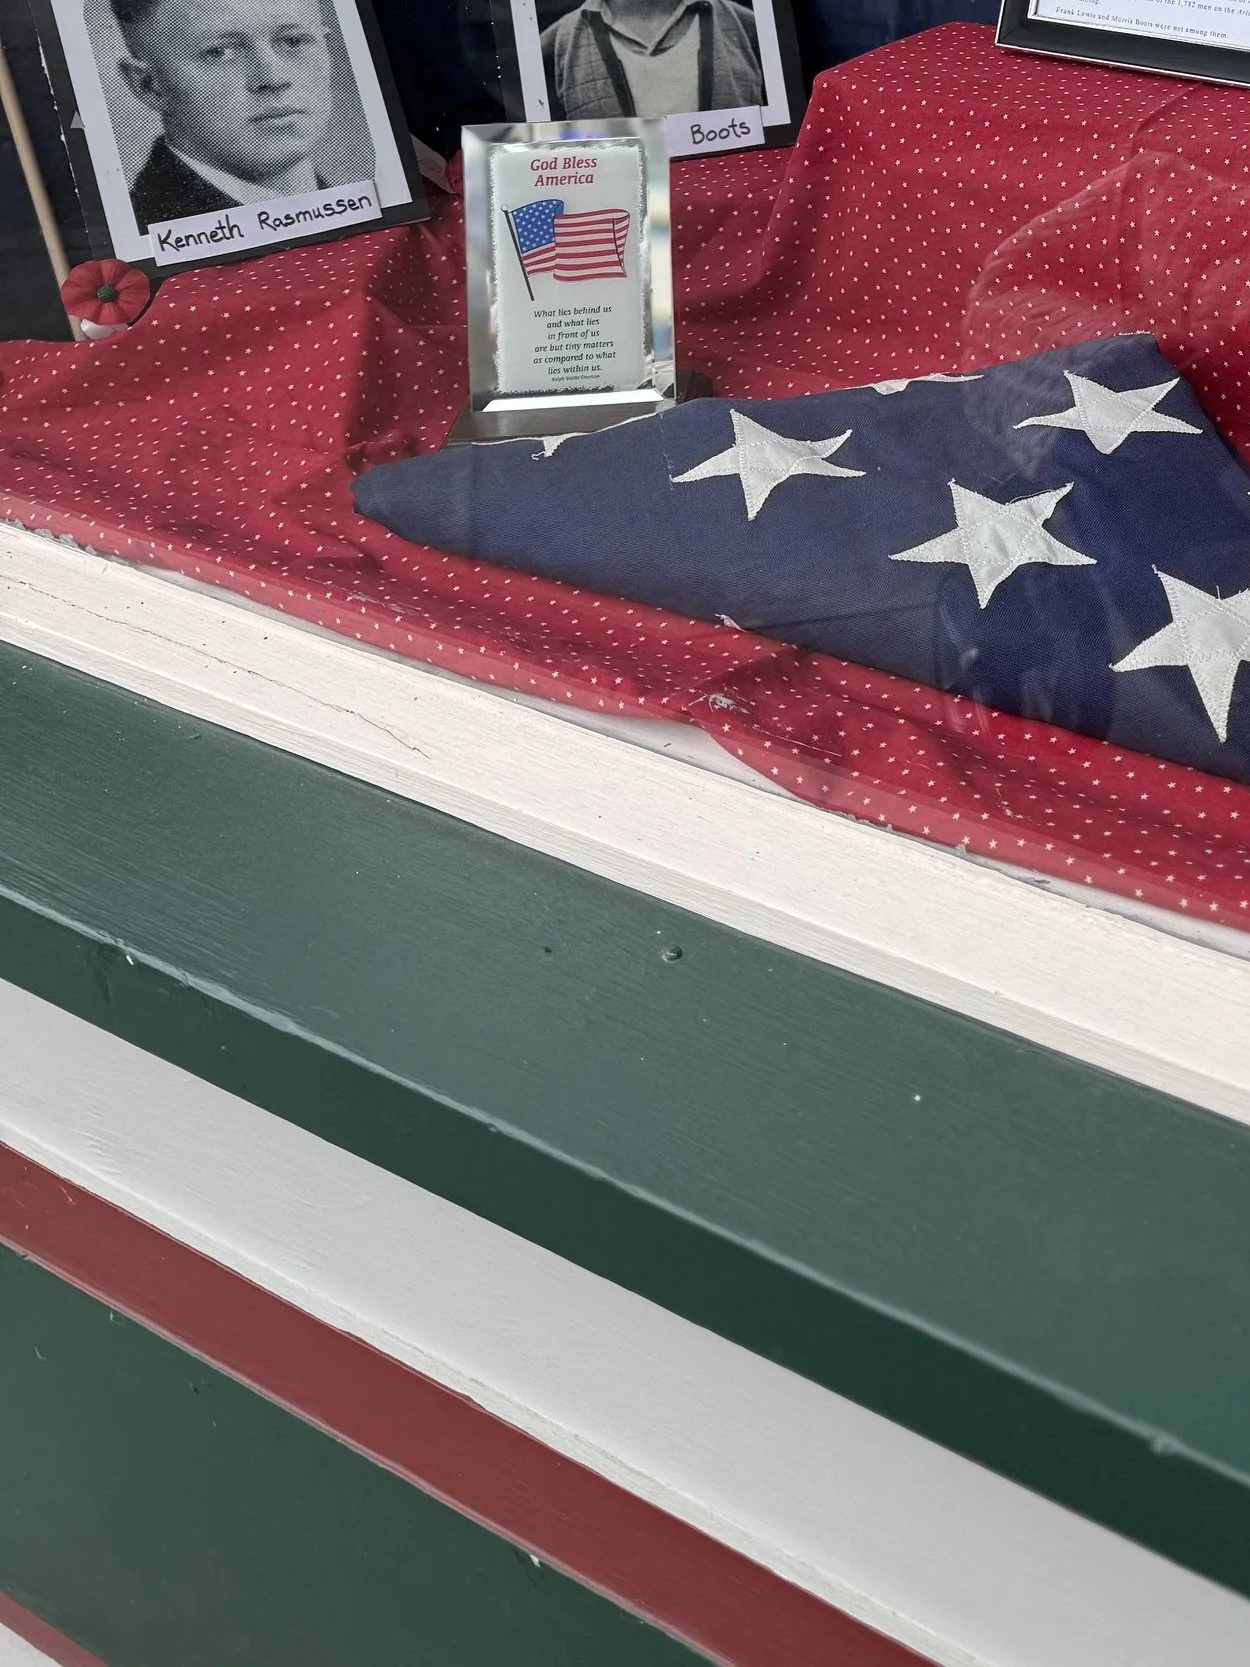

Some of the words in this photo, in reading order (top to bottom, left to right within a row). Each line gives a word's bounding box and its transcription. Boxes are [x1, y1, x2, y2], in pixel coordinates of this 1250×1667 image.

[1055, 6, 1074, 14] Frank
[1077, 9, 1095, 18] Lewis
[1098, 12, 1109, 20] and
[1111, 14, 1133, 24] Morris
[1135, 18, 1153, 27] Boots
[1185, 27, 1207, 37] among
[690, 118, 750, 145] Boots
[531, 157, 557, 171] God
[563, 156, 597, 169] Bless
[534, 172, 594, 186] America
[157, 214, 244, 252] Kenneth
[257, 195, 372, 231] Rasmussen
[559, 308, 571, 316] lies
[574, 306, 600, 315] behind
[547, 320, 562, 328] and
[564, 319, 583, 327] what
[557, 331, 578, 341] front
[580, 330, 589, 339] of
[566, 343, 581, 351] tiny
[583, 341, 614, 349] matters
[545, 353, 583, 364] compared
[563, 365, 589, 373] within
